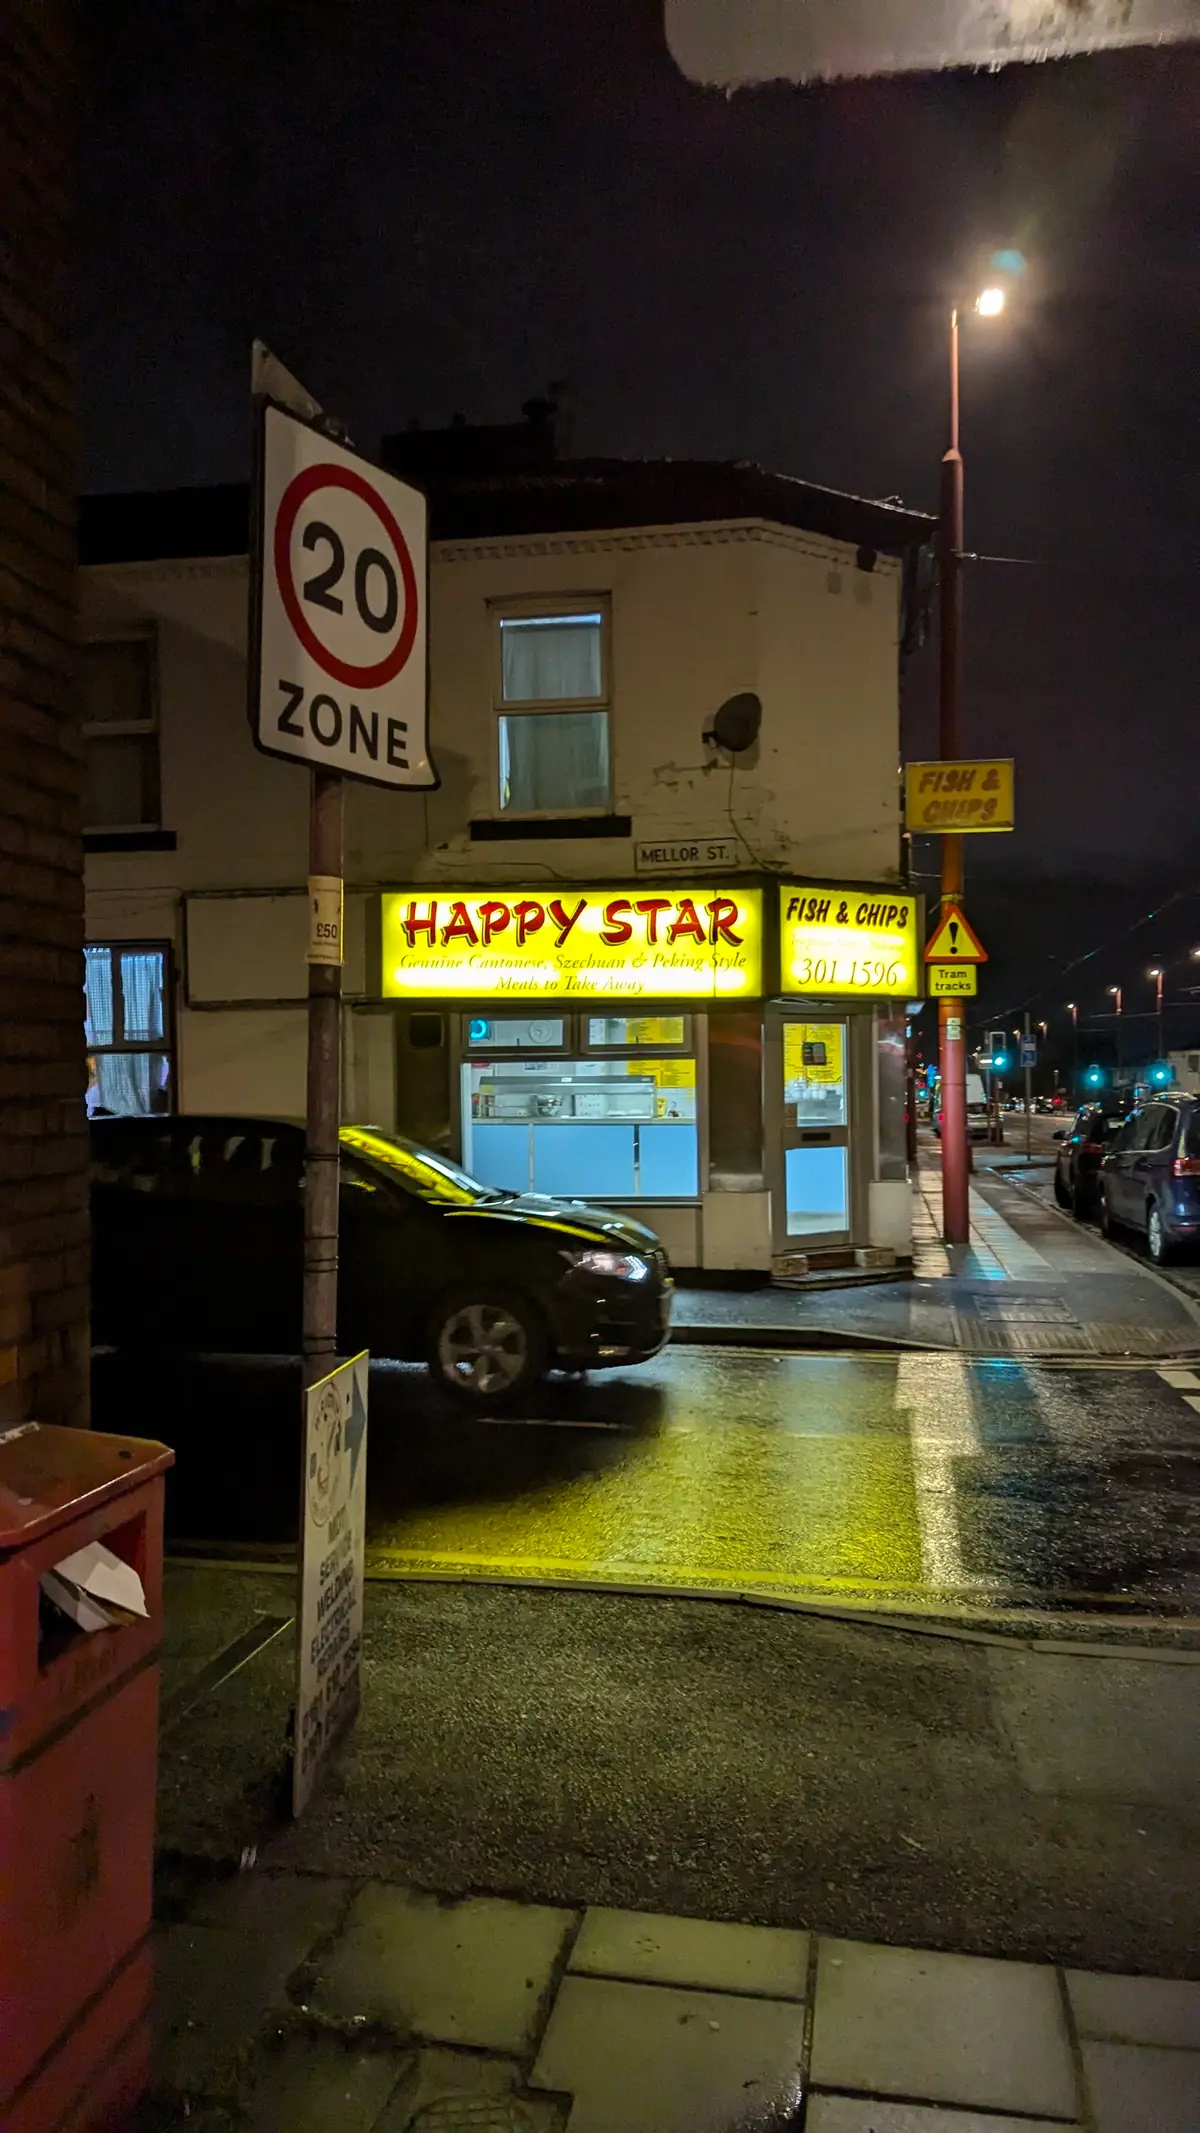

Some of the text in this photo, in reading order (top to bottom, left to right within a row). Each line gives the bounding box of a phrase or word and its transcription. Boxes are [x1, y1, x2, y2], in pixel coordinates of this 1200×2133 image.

[302, 520, 399, 635] 20
[277, 679, 410, 770] ZONE
[918, 768, 1001, 794] FISH &
[922, 797, 998, 824] CHIPS
[641, 845, 730, 863] MELLOR ST.
[401, 897, 744, 948] HAPPY STAR
[786, 897, 910, 929] FISH & CHIPS
[316, 922, 338, 939] £50
[400, 951, 748, 973] Genuine Cantonese, Szechuan & Peking Style
[798, 958, 901, 988] 301 1596
[937, 968, 968, 980] Tram
[494, 975, 646, 996] Meals to Take Away
[934, 980, 972, 992] tracks
